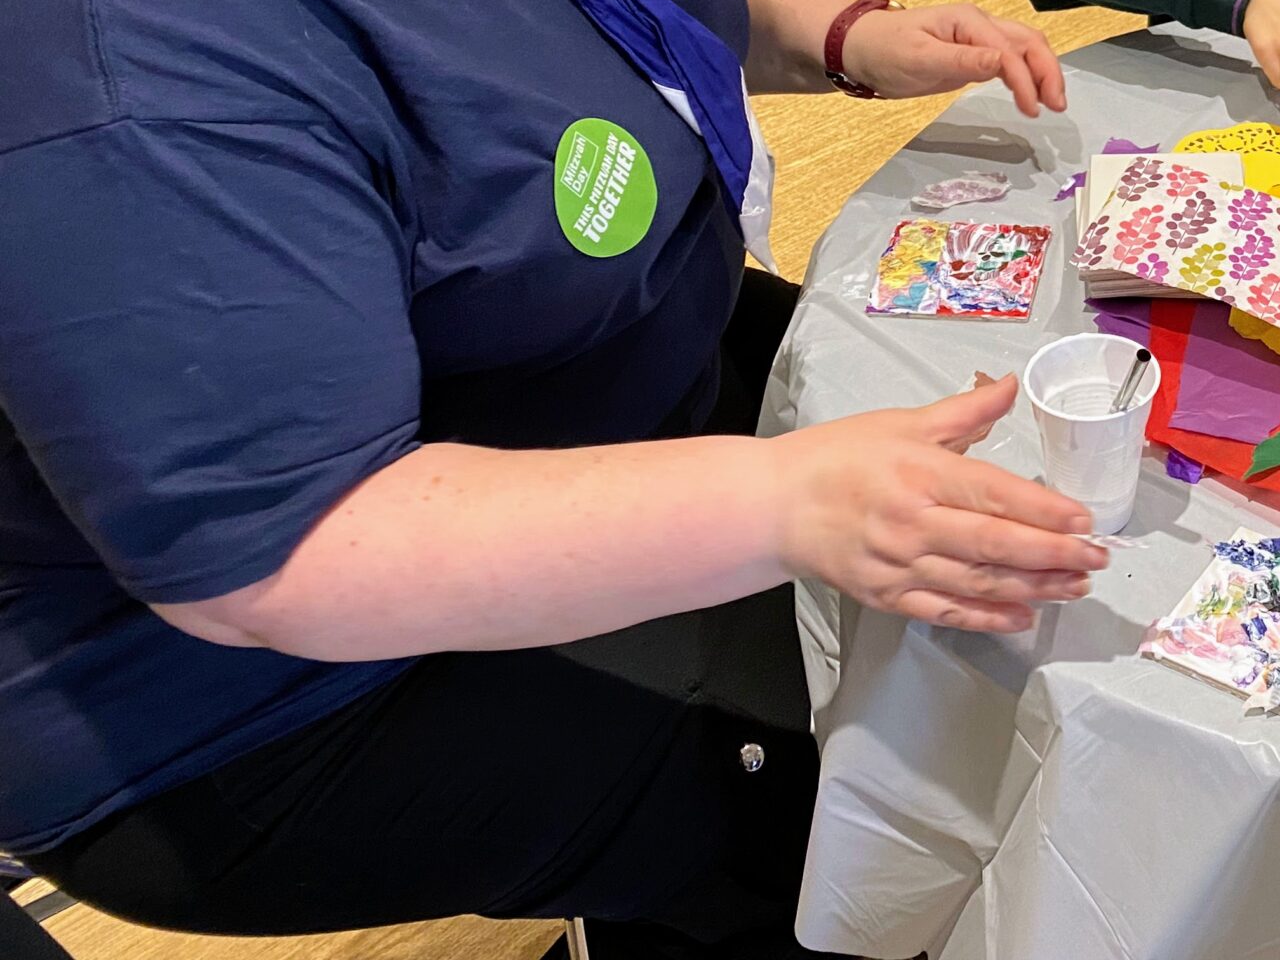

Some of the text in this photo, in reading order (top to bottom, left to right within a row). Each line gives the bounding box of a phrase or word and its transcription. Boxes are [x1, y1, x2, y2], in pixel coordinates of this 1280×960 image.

[563, 137, 587, 186] Mitzvah
[571, 166, 589, 192] Day
[573, 132, 619, 232] THIS MITZVAH DAY
[582, 141, 637, 243] TOGETHER
